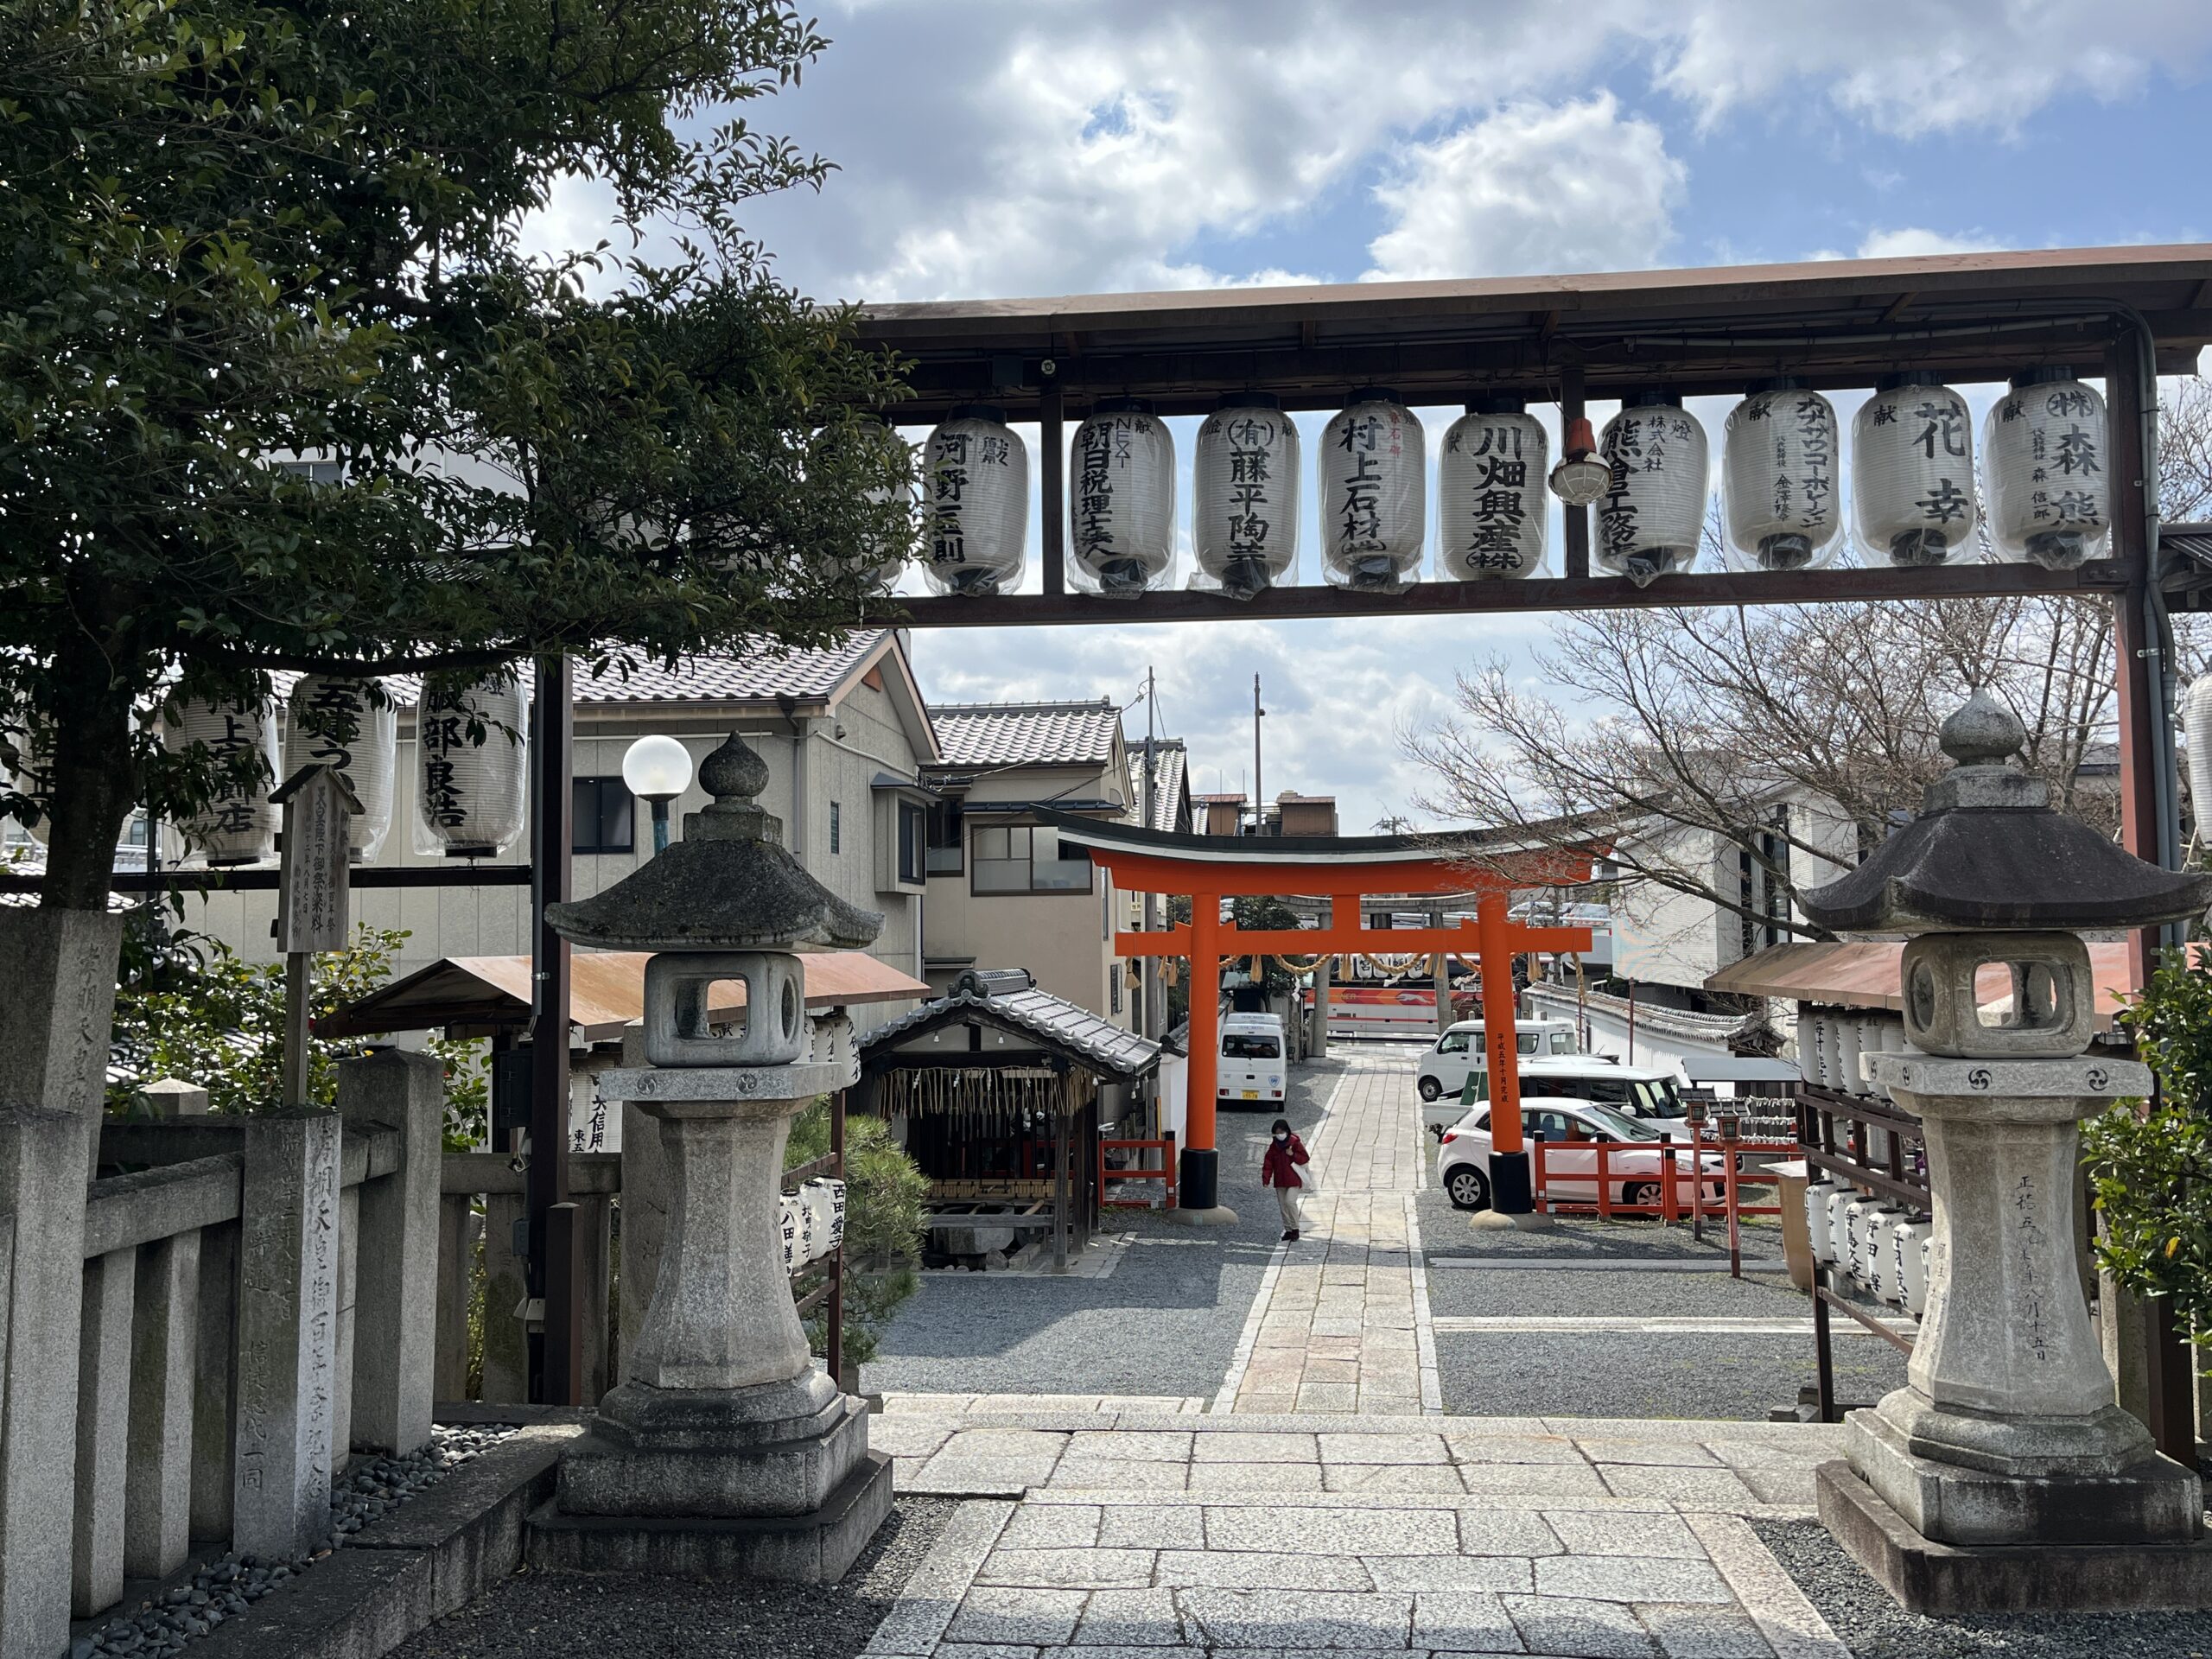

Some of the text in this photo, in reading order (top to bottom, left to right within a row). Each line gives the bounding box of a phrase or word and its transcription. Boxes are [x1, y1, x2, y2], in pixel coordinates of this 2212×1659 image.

[1116, 417, 1132, 469] NEXT
[1642, 416, 1667, 473] 株式会社
[1079, 421, 1124, 559] 朝日税理士法人
